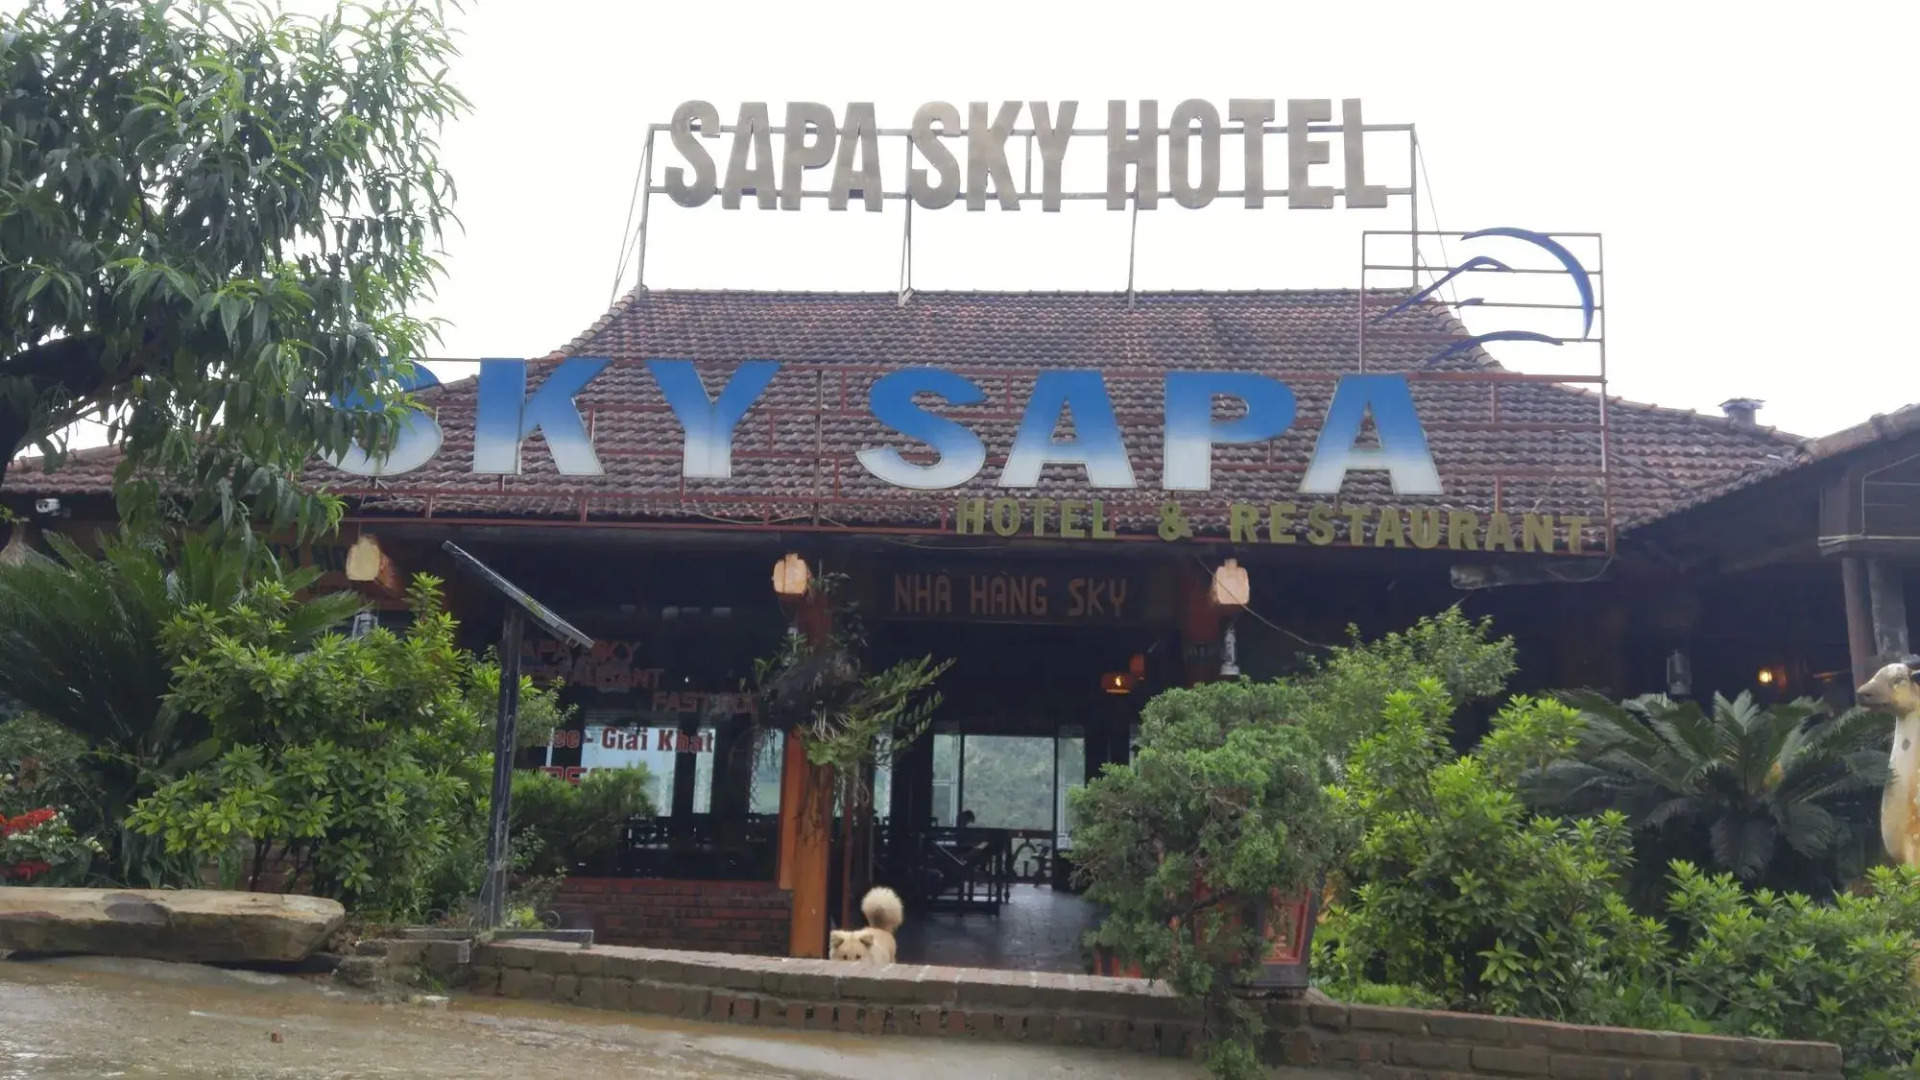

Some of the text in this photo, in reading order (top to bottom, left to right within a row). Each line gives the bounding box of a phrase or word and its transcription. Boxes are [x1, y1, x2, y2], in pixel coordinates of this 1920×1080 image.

[664, 98, 1388, 212] SAPA SKY HOTEL
[316, 357, 1444, 495] SKY SAPA
[956, 497, 1591, 554] HOTEL & RESTAURANT
[893, 568, 1128, 618] NHÀ HÀNG SKY
